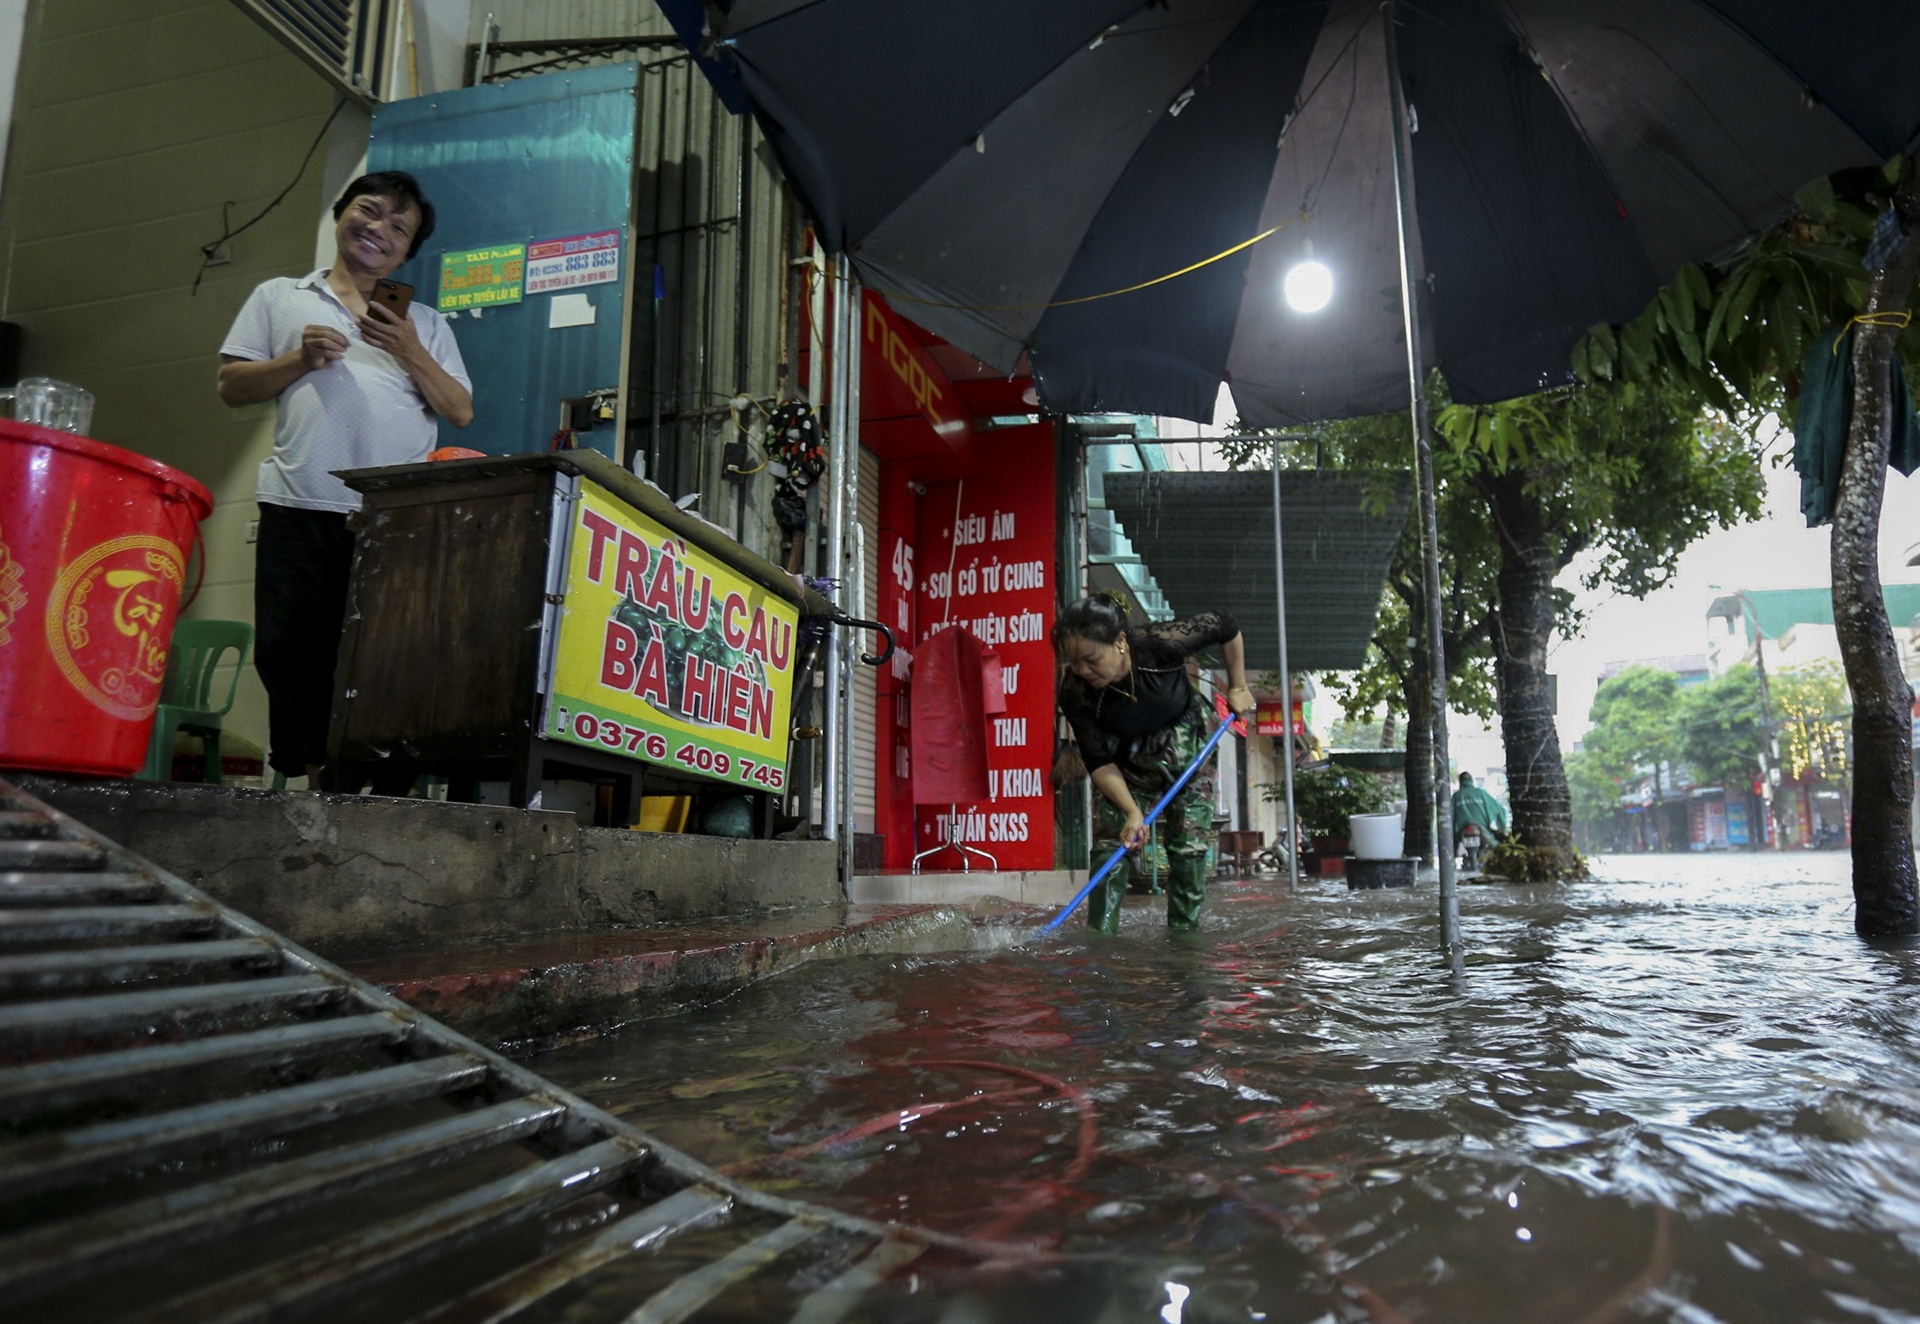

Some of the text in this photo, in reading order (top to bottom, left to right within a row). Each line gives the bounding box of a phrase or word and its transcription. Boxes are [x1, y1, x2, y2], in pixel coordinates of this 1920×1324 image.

[466, 251, 489, 262] TAXI
[565, 254, 589, 272] 883
[592, 249, 615, 268] 883
[955, 510, 1015, 545] SIÊU ÂM
[892, 537, 914, 591] 45
[958, 558, 979, 596] CỔ
[982, 556, 1001, 593] TỬ
[1004, 561, 1044, 591] CUNG
[583, 508, 711, 630] TRẦU
[723, 593, 791, 670] CAU
[972, 612, 1006, 649] HIỆN
[1009, 608, 1043, 643] SỚM
[602, 620, 774, 739] BÀ HIỀN
[575, 715, 783, 787] 0376 409 745
[993, 718, 1027, 746] THAI
[1003, 768, 1043, 798] KHOA
[957, 805, 986, 842] VẤN
[989, 812, 1028, 842] SKSS
